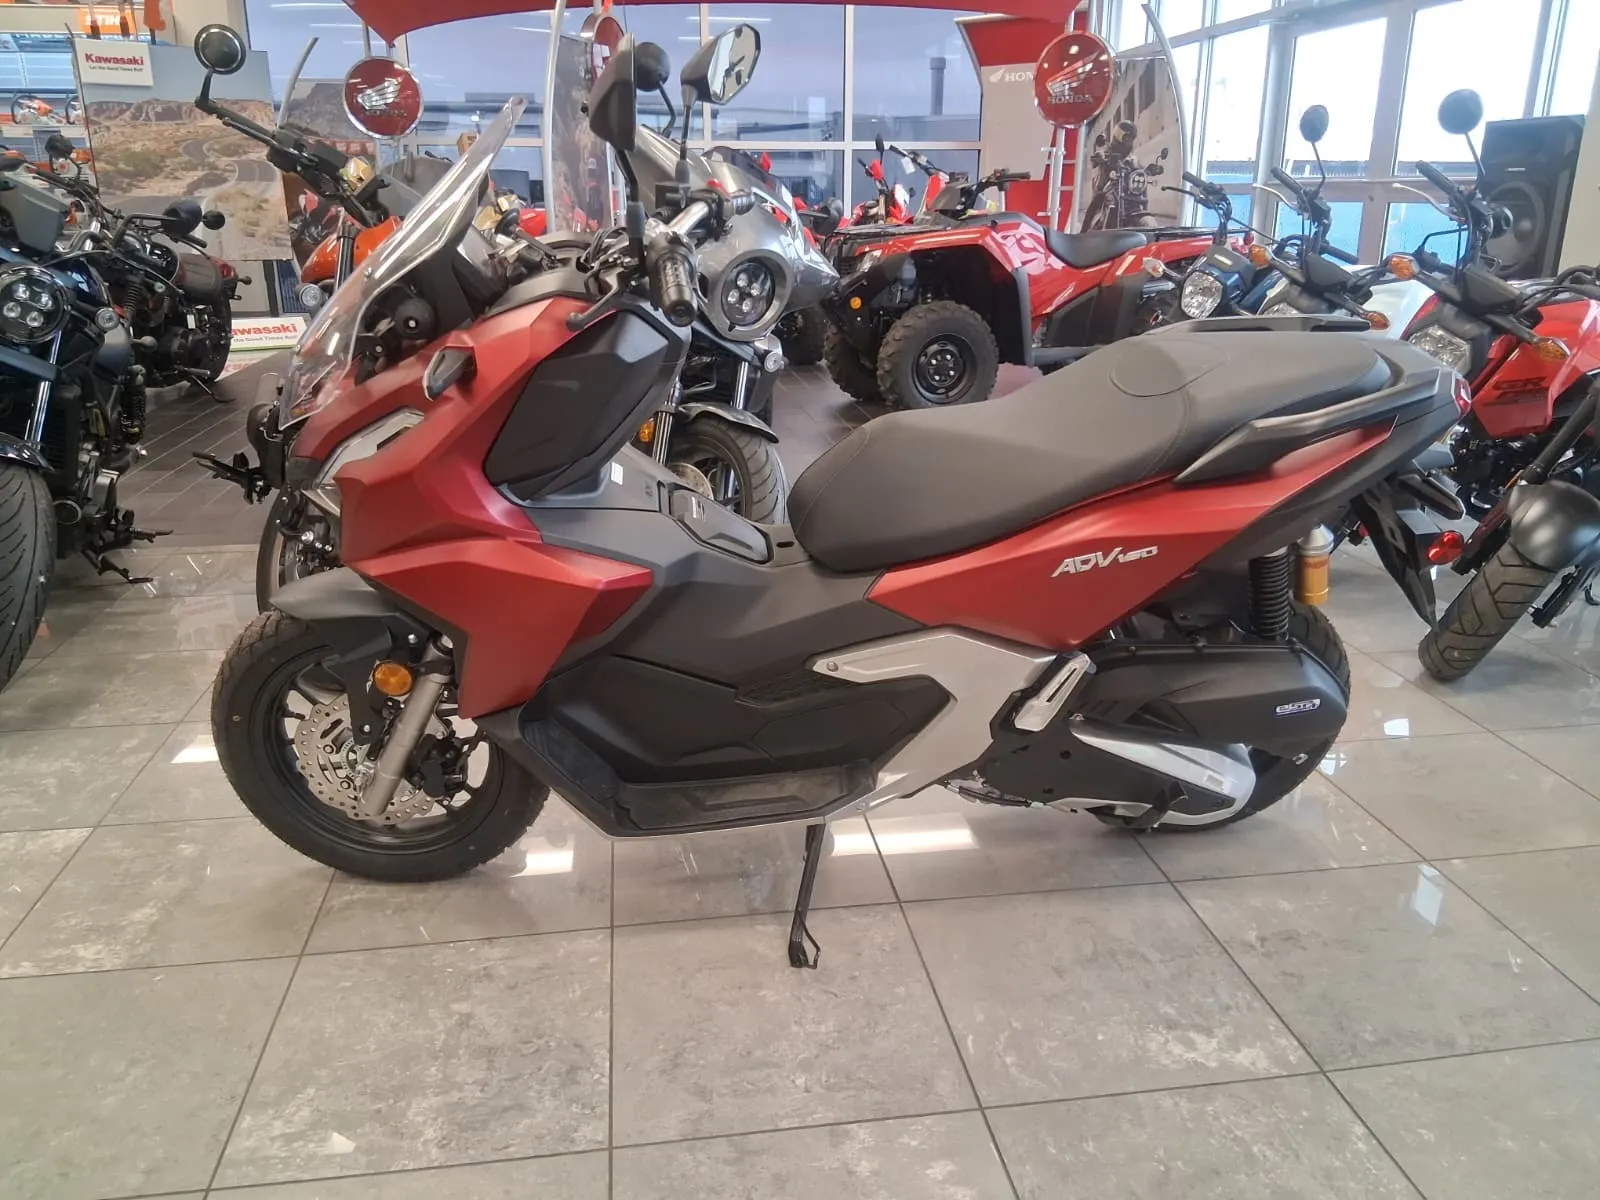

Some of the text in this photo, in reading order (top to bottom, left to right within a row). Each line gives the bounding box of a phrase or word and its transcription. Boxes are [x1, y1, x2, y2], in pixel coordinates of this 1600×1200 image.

[84, 52, 144, 66] Kawasaki
[1005, 71, 1034, 82] HON
[1047, 94, 1094, 105] HONDA
[231, 323, 298, 336] awasaki
